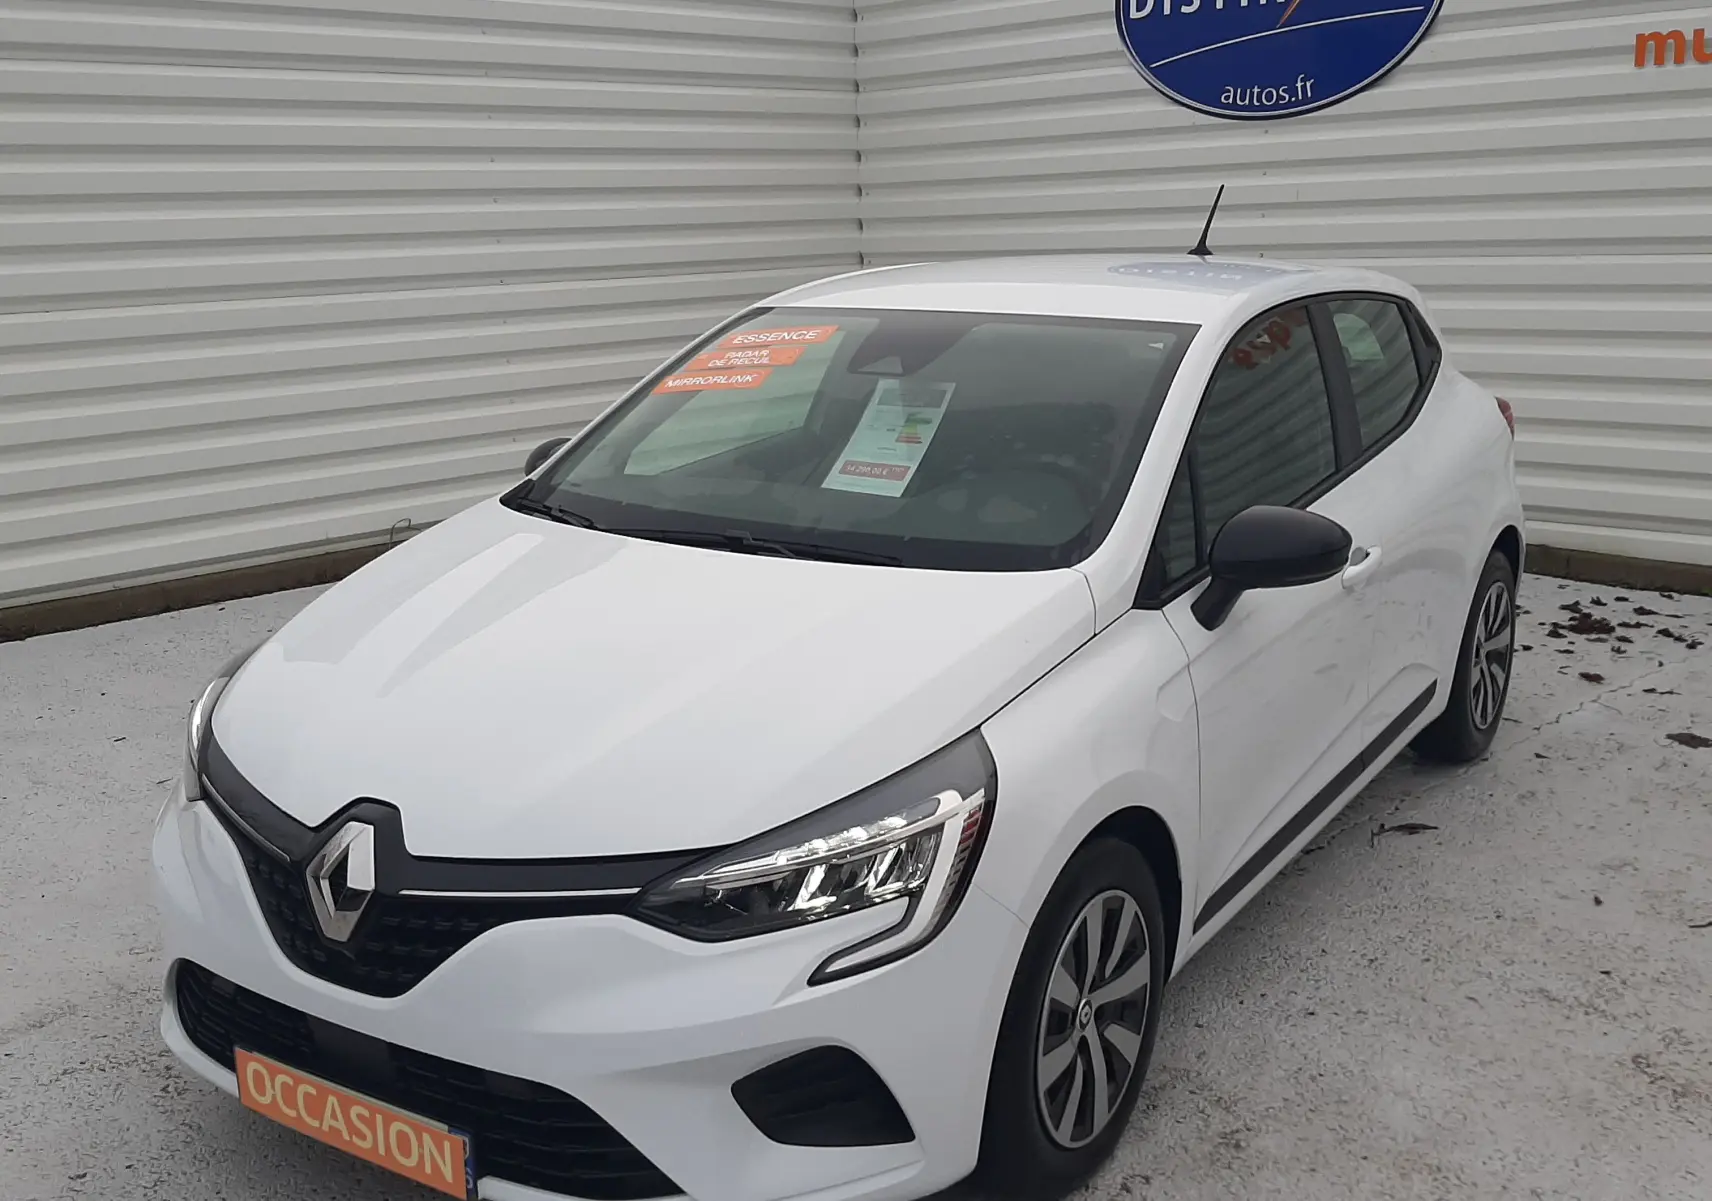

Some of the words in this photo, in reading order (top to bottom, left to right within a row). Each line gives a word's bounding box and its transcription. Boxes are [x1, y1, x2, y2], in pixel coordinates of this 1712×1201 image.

[1221, 74, 1314, 105] autos.fr
[732, 329, 822, 344] ESSENCE
[724, 349, 770, 359] RADAR
[708, 359, 728, 367] DE
[728, 357, 770, 366] RECUL
[664, 373, 758, 388] MIRRORLINK
[246, 1061, 453, 1183] OCCASION
